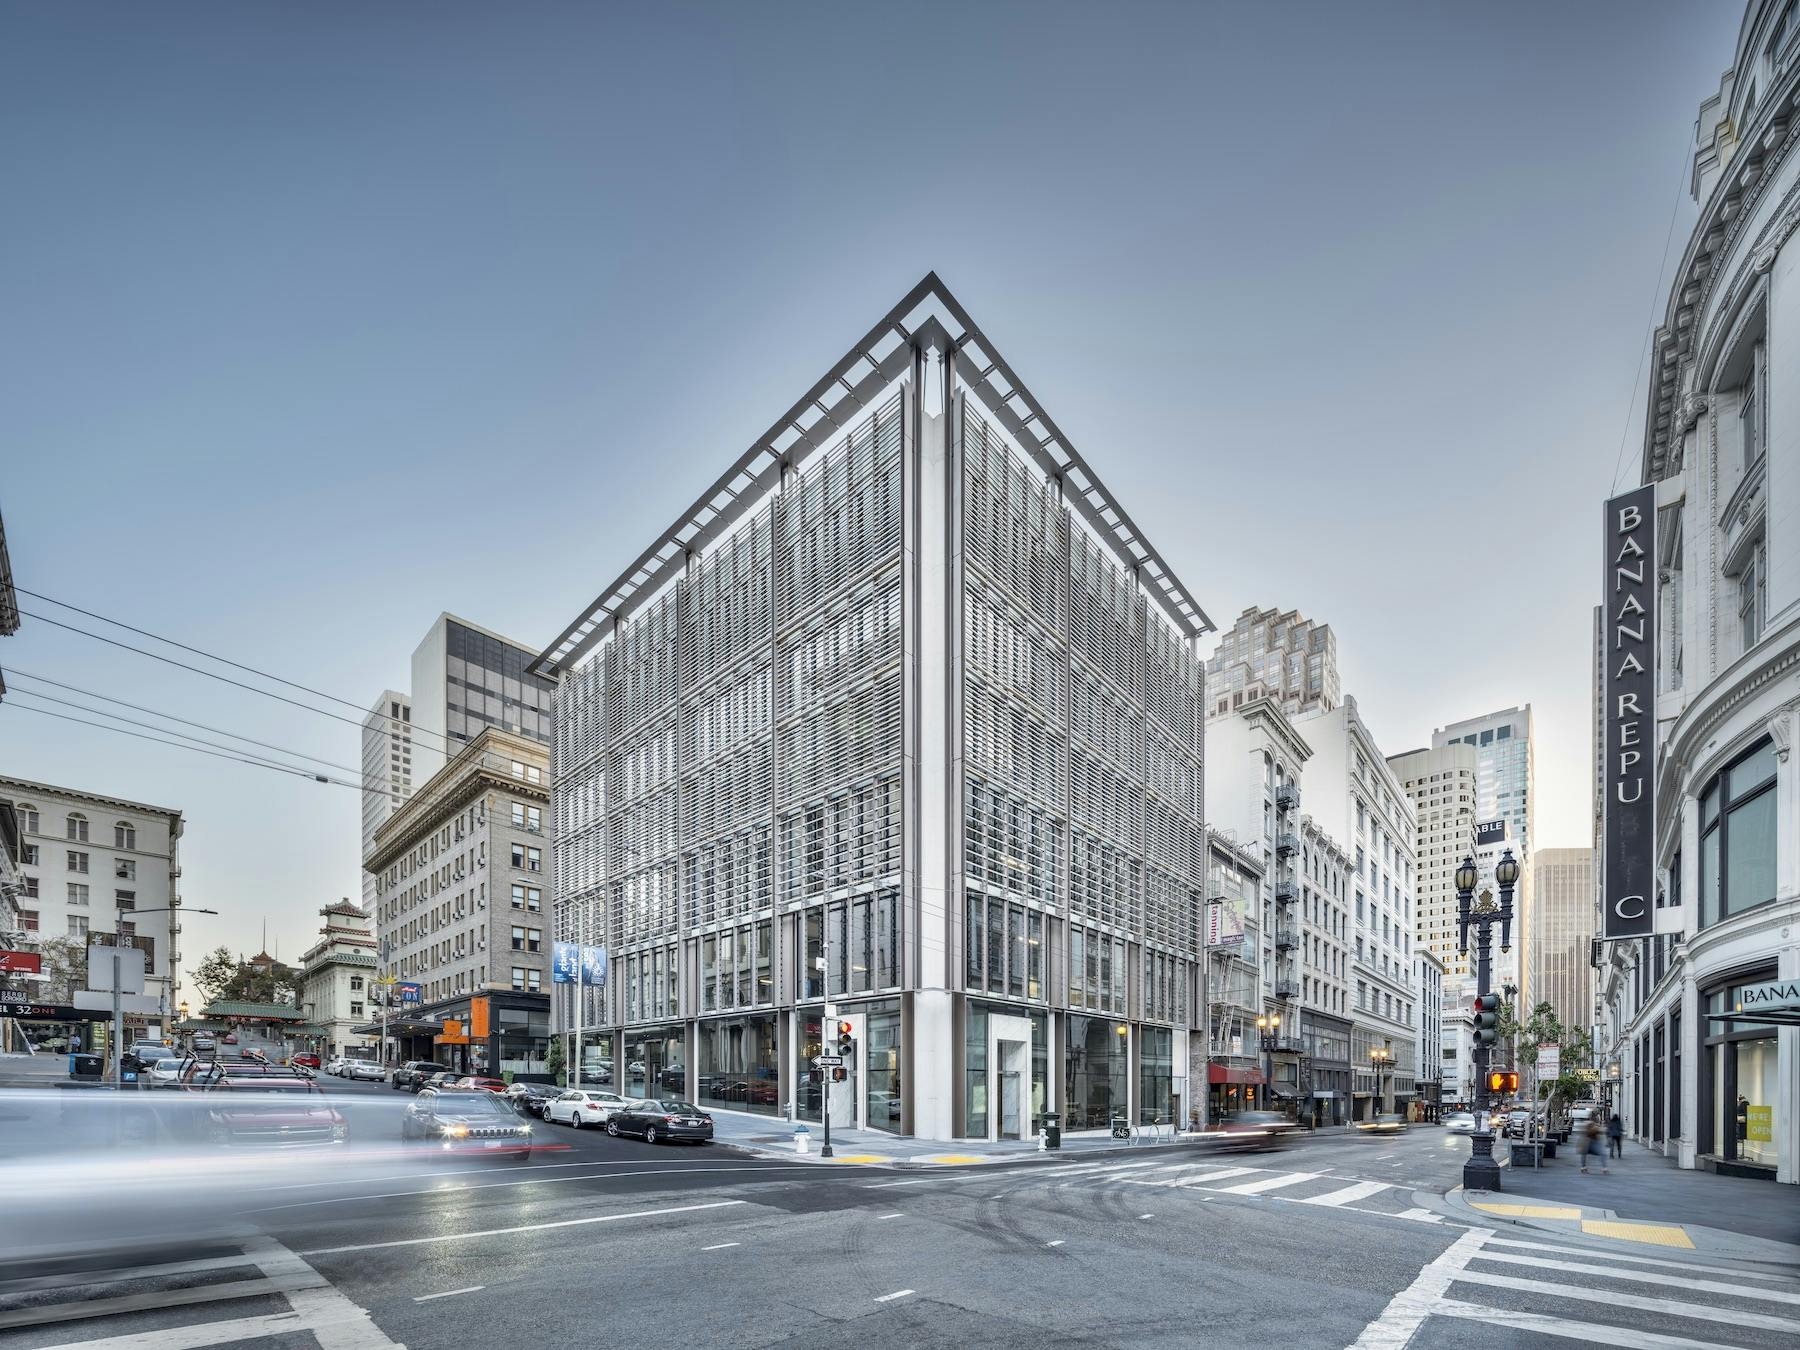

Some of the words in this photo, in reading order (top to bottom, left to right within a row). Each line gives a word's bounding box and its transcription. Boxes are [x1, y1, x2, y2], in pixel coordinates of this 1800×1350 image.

[1615, 505, 1645, 679] BANANA
[1209, 904, 1219, 944] tanning
[1744, 984, 1800, 1004] BANA
